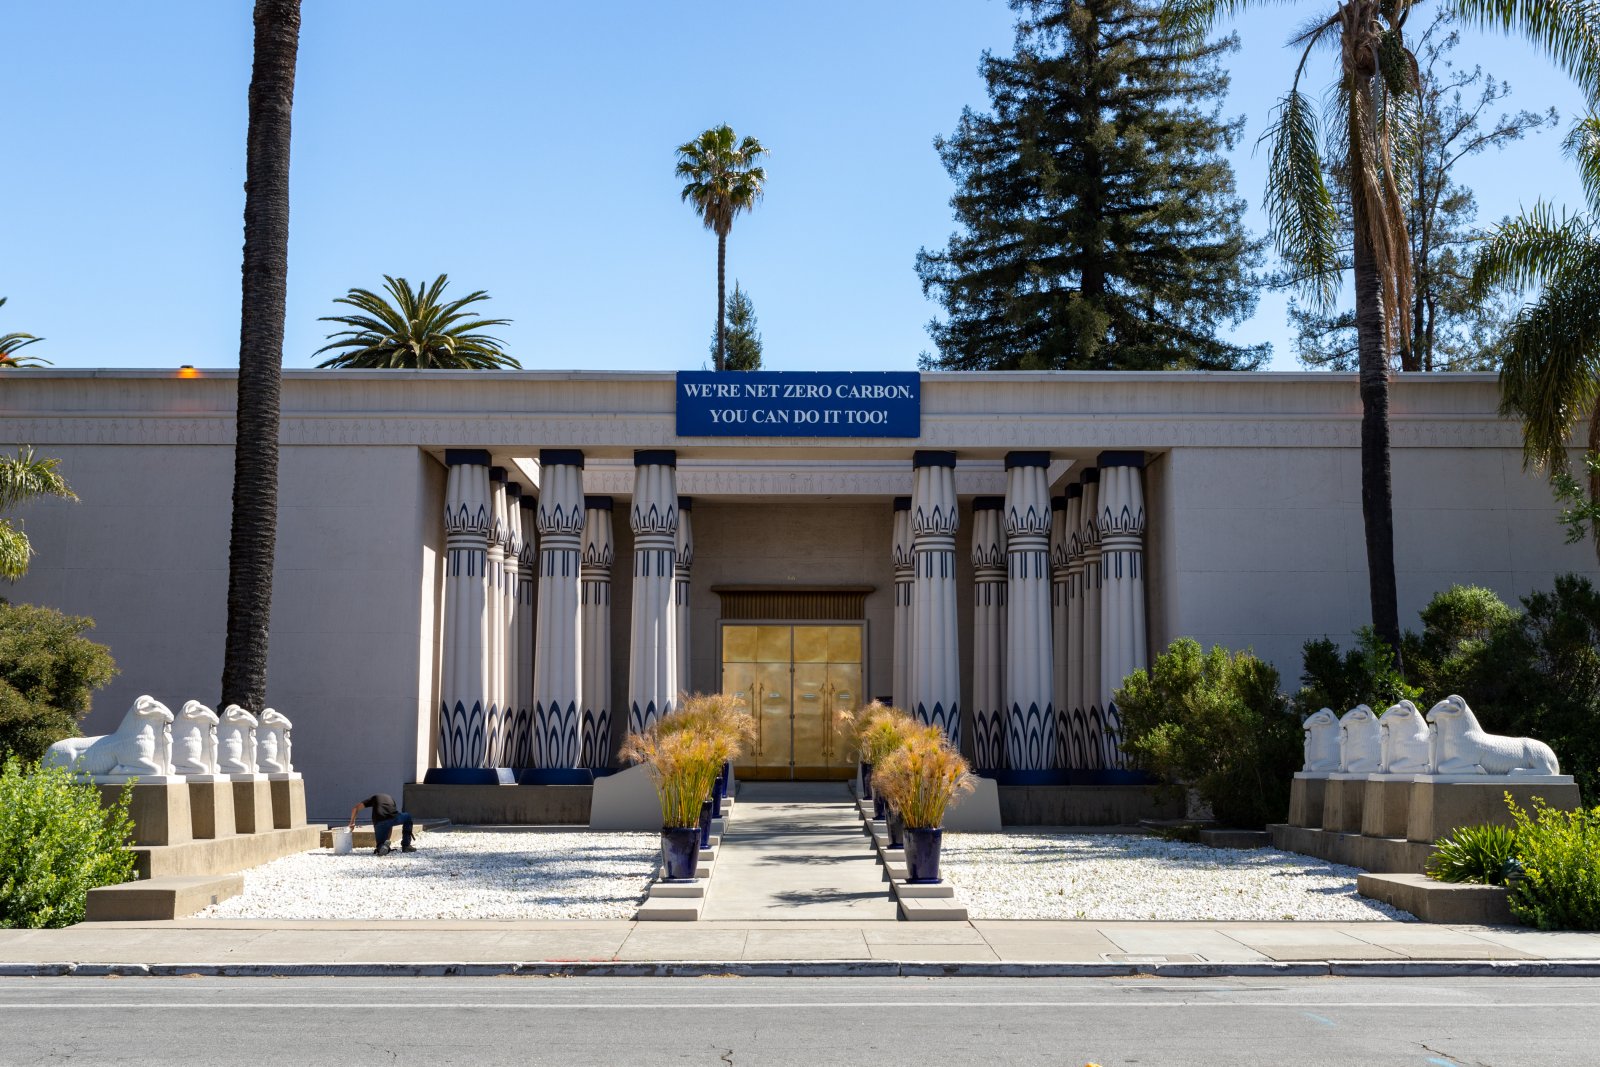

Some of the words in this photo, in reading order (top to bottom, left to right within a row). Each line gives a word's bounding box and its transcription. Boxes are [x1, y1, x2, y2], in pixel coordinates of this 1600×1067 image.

[684, 384, 741, 398] WE'RE
[745, 384, 780, 398] NET
[783, 384, 832, 398] ZERO
[835, 384, 914, 399] CARBON.
[709, 409, 748, 423] YOU
[752, 409, 789, 423] CAN
[794, 410, 820, 424] DO
[824, 410, 842, 424] IT
[844, 410, 888, 424] TOO!
